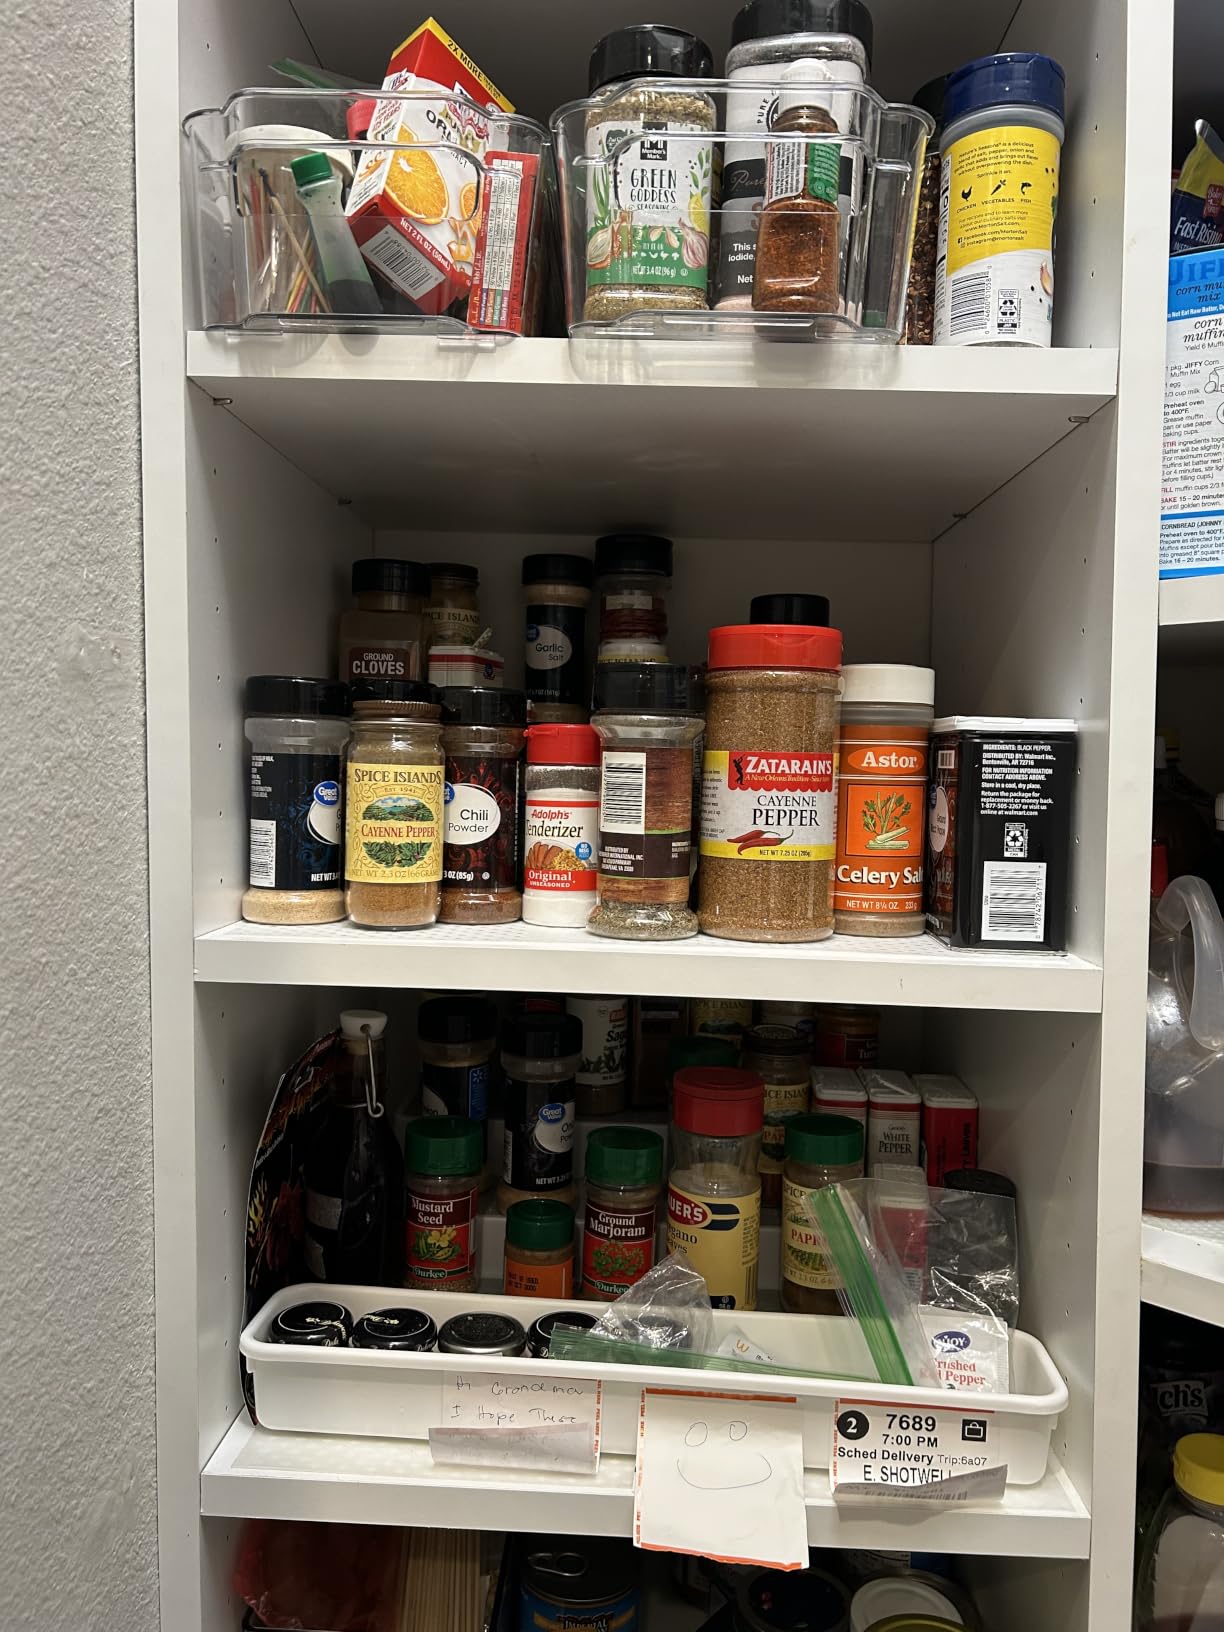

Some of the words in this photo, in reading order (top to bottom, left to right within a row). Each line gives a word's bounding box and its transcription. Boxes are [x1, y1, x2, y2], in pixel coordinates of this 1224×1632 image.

[448, 40, 459, 54] 2X
[459, 53, 484, 82] MORE
[757, 96, 769, 124] PURE
[630, 168, 677, 189] GREEN
[630, 189, 677, 203] GODDESS
[956, 203, 977, 213] CHICKEN
[400, 218, 413, 232] NET
[1174, 216, 1200, 239] Fast
[733, 243, 750, 251] This
[737, 275, 753, 283] Net
[1175, 285, 1201, 296] corn
[1197, 291, 1222, 303] mix
[1194, 317, 1223, 330] corn
[1185, 361, 1203, 369] JIFFY
[1164, 401, 1188, 409] Preheat
[1161, 522, 1196, 530] CORNBREAD
[535, 643, 564, 653] Garlic
[363, 652, 394, 661] GROUND
[548, 653, 564, 661] Salt
[352, 661, 405, 675] CLOVES
[745, 756, 832, 775] ZATARAIN'S
[861, 751, 917, 768] Astor
[354, 768, 391, 783] SPICE
[393, 771, 442, 785] ISLANDS
[318, 787, 338, 796] Great
[757, 794, 817, 807] CAYENNE
[460, 809, 489, 821] Chili
[531, 809, 570, 821] Adolph's
[751, 808, 820, 827] PEPPER
[361, 824, 404, 838] CAYENNE
[406, 825, 436, 838] PEPPER
[448, 822, 489, 833] Powder
[311, 873, 323, 882] NET
[323, 873, 332, 881] WT
[366, 869, 379, 877] WT
[381, 869, 394, 877] 2.3
[448, 871, 456, 879] OZ
[456, 872, 474, 881] (85g)
[528, 870, 572, 881] Original
[837, 865, 901, 889] Celery
[846, 900, 861, 909] NET
[862, 901, 873, 909] WT
[883, 1132, 910, 1142] WHITE
[879, 1141, 912, 1154] PEPPER
[411, 1198, 453, 1213] Mustard
[670, 1195, 703, 1222] UER'S
[417, 1213, 443, 1225] Seed
[599, 1213, 635, 1226] Ground
[589, 1217, 646, 1238] Marjoram
[936, 1359, 976, 1372] rushed
[945, 1370, 986, 1386] Pepper
[451, 1405, 461, 1419] I
[478, 1405, 515, 1425] Hope
[846, 1417, 858, 1433] 2
[886, 1413, 937, 1432] 7689
[882, 1433, 912, 1446] 7:00
[917, 1436, 938, 1448] PM
[838, 1446, 877, 1460] Sched
[881, 1449, 934, 1466] Delivery
[863, 1464, 876, 1482] E.
